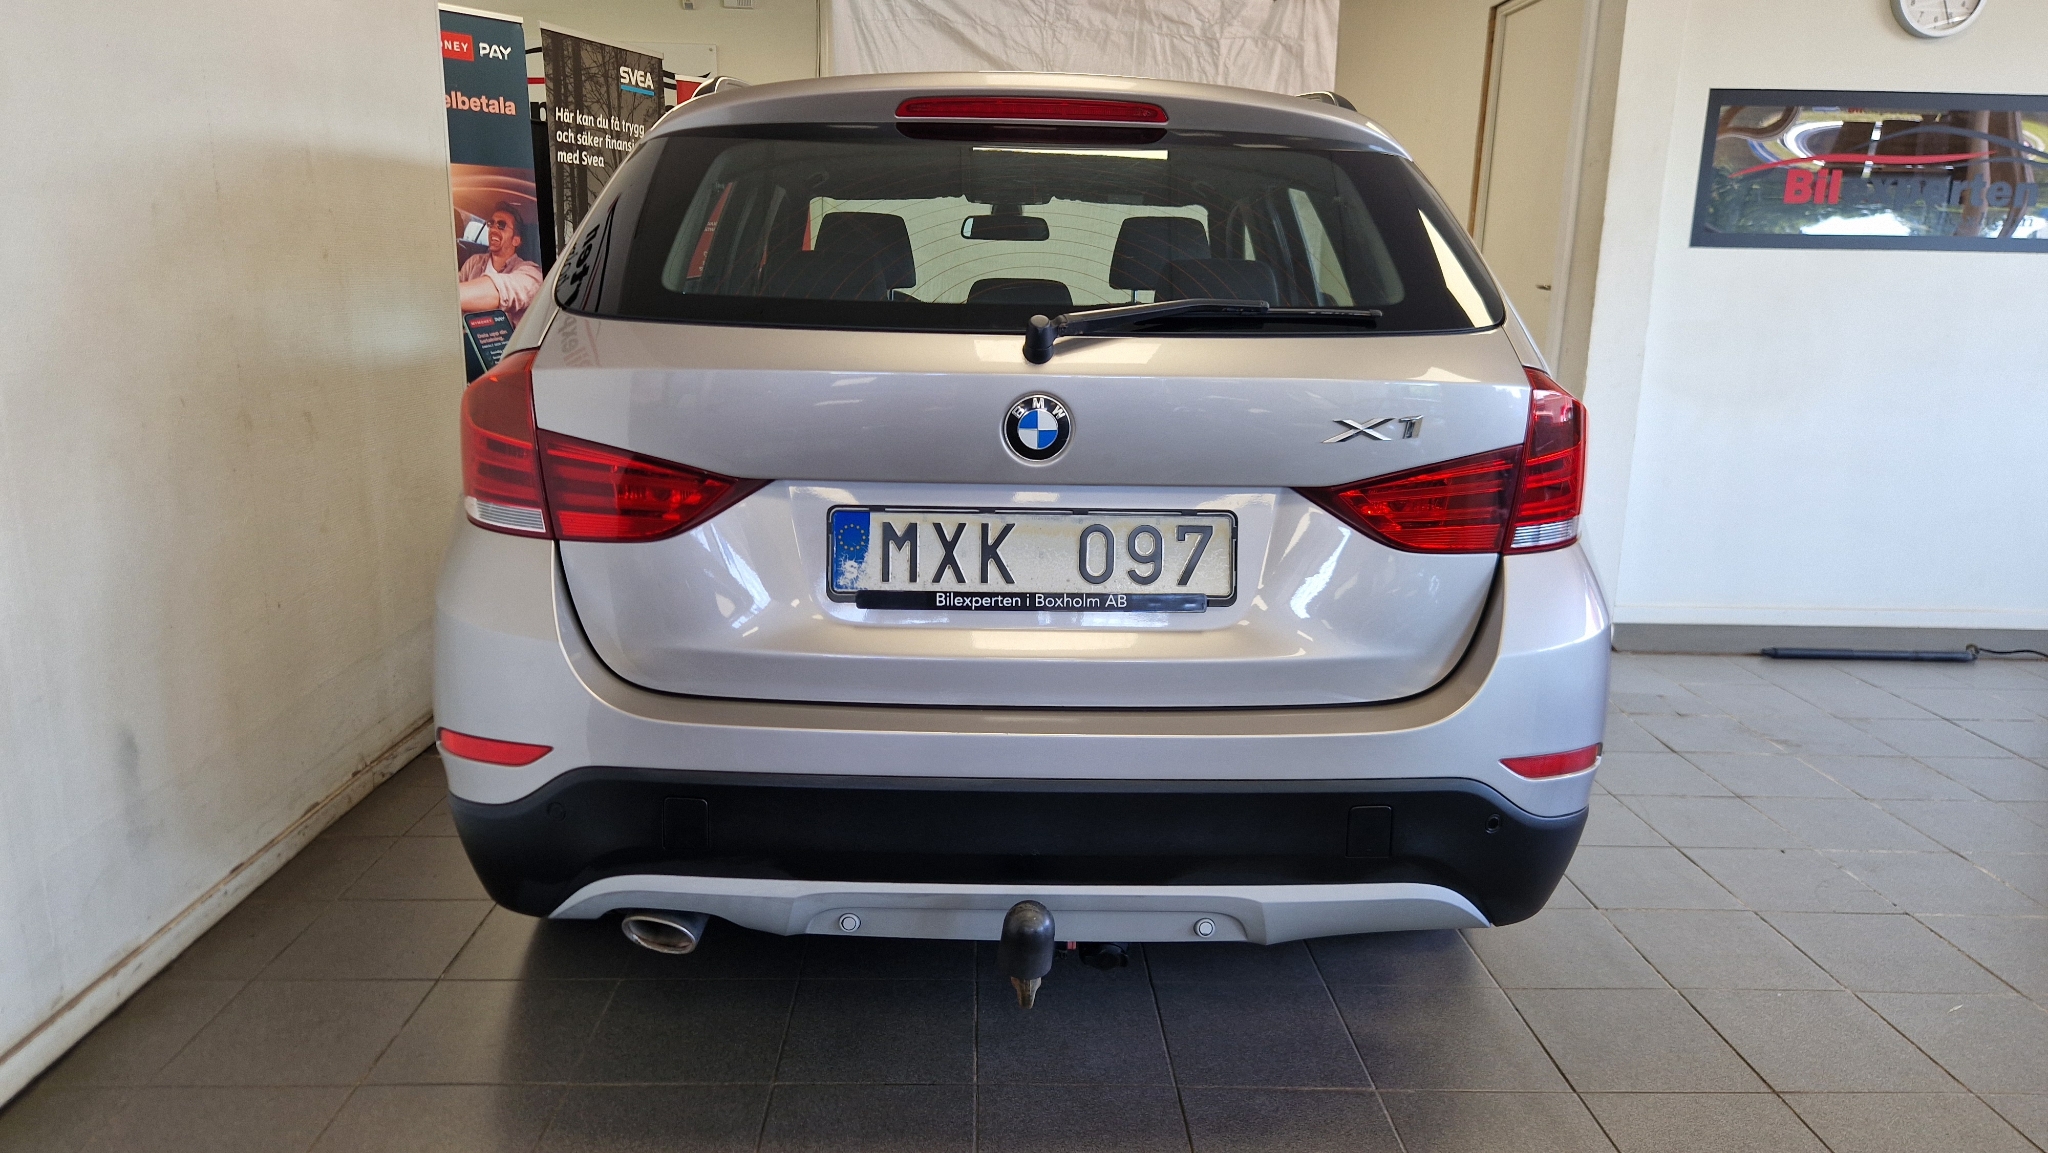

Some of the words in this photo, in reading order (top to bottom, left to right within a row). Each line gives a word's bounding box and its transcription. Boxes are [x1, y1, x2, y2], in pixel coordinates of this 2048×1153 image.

[440, 39, 469, 53] NEY
[479, 42, 512, 60] PAY
[619, 66, 654, 89] SVEA
[555, 106, 574, 123] Här
[576, 109, 595, 127] kan
[596, 113, 609, 129] du
[610, 115, 620, 132] få
[622, 120, 645, 138] trygg
[556, 128, 575, 145] och
[577, 131, 603, 148] säker
[557, 149, 580, 165] med
[581, 151, 605, 168] Svea
[1011, 397, 1066, 420] BMW
[1320, 415, 1424, 443] X1
[881, 521, 1016, 585] MXK
[1078, 523, 1215, 586] 097
[935, 592, 1021, 610] Bilexperten
[1026, 593, 1030, 607] i
[1035, 593, 1100, 608] Boxholm
[1105, 594, 1127, 608] AB
